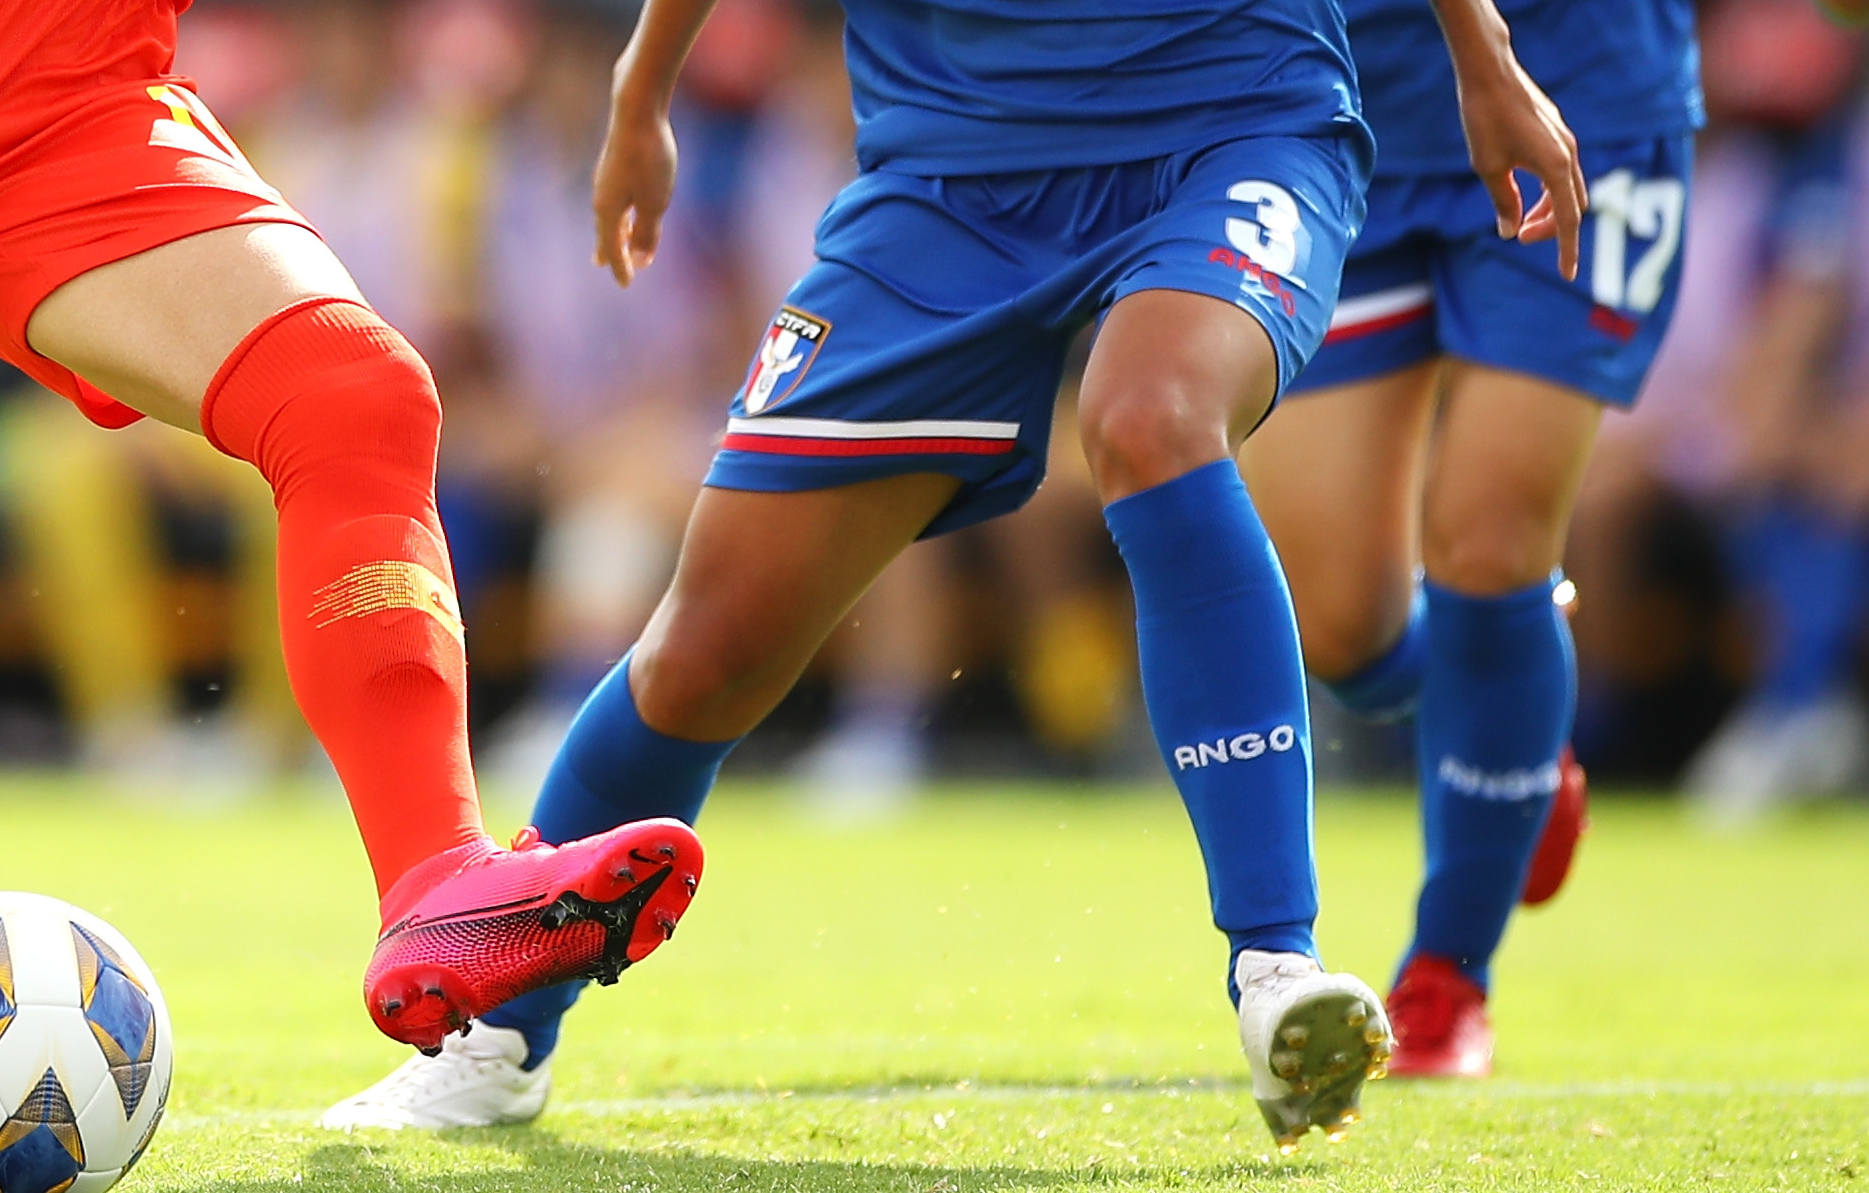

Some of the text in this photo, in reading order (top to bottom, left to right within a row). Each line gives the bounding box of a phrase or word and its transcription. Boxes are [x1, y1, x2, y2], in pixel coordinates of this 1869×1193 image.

[1225, 179, 1300, 277] 3
[1208, 248, 1296, 317] ANGO
[776, 311, 822, 340] CTFA
[1174, 724, 1295, 770] ANGO
